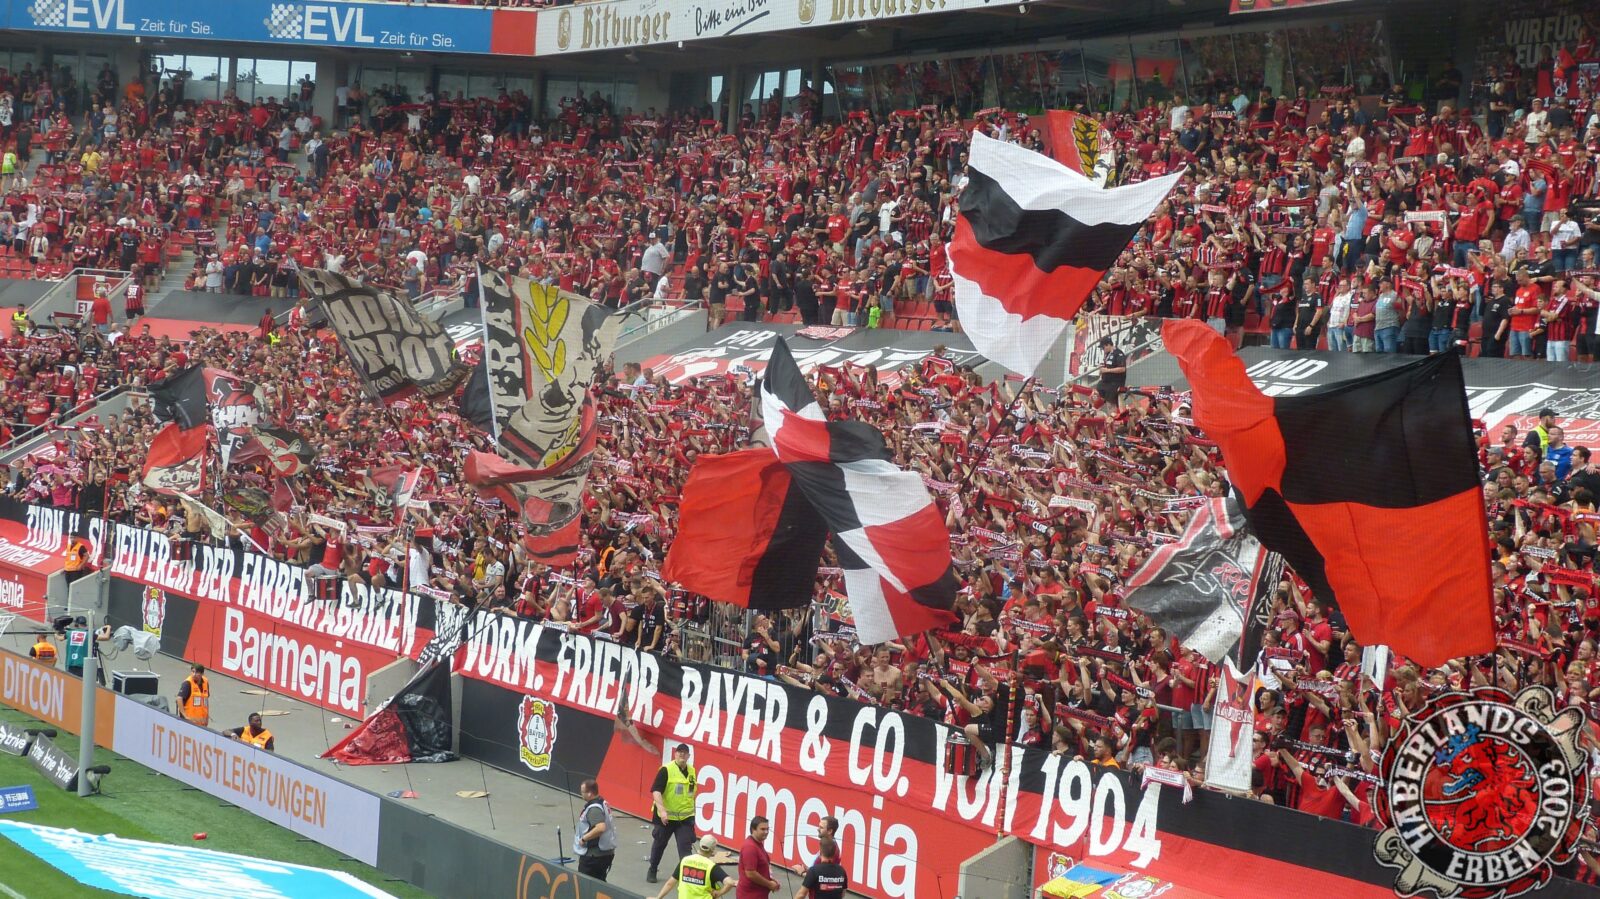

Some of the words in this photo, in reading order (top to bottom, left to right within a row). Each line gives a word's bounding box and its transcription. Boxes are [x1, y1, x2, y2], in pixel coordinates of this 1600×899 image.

[67, 0, 135, 30] EVL
[141, 19, 165, 32] Zeit
[169, 20, 187, 33] für
[191, 22, 214, 35] Sie.
[304, 5, 374, 43] EVL
[581, 5, 671, 49] Bitburger
[695, 7, 721, 36] Bitte
[1504, 17, 1540, 44] WIR
[380, 31, 406, 45] Zeit
[409, 33, 428, 46] für
[432, 34, 455, 47] Sie.
[222, 607, 362, 711] Barmenia
[4, 656, 64, 722] DITCON
[19, 504, 64, 552] TURN
[197, 545, 235, 603] DER
[464, 609, 542, 691] VORM.
[552, 633, 663, 728] FRIEDR.
[672, 665, 789, 764] BAYER
[800, 694, 831, 776] &
[848, 706, 909, 797] CO.
[1030, 754, 1162, 868] 1904
[151, 722, 165, 757] IT
[168, 731, 327, 829] DIENSTLEISTUNGEN
[663, 737, 918, 899] armenia
